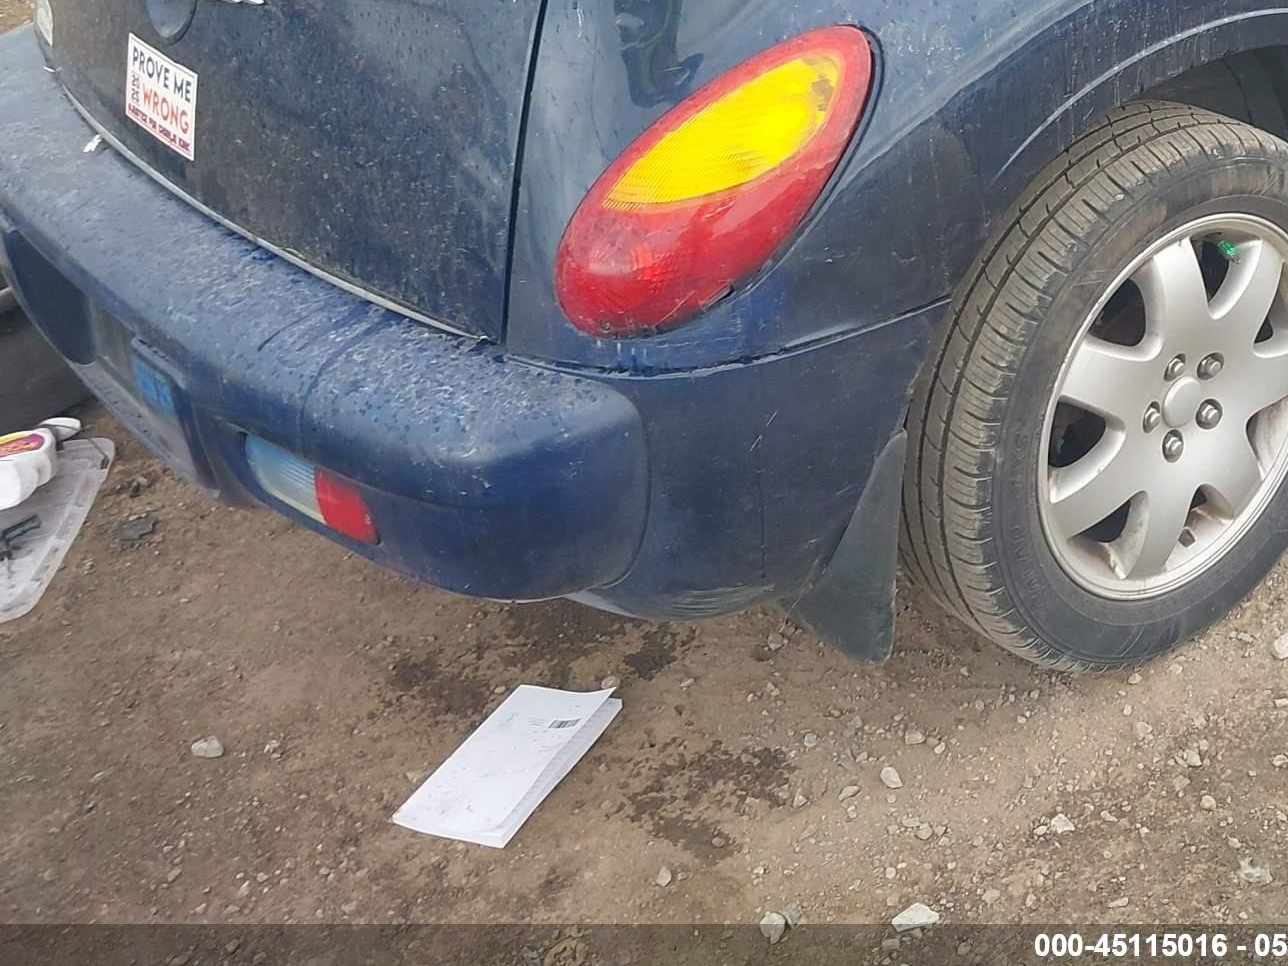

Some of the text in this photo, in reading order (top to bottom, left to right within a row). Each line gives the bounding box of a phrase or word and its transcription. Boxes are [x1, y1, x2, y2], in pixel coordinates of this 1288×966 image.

[132, 45, 192, 103] PROVE ME
[142, 82, 189, 135] WRONG
